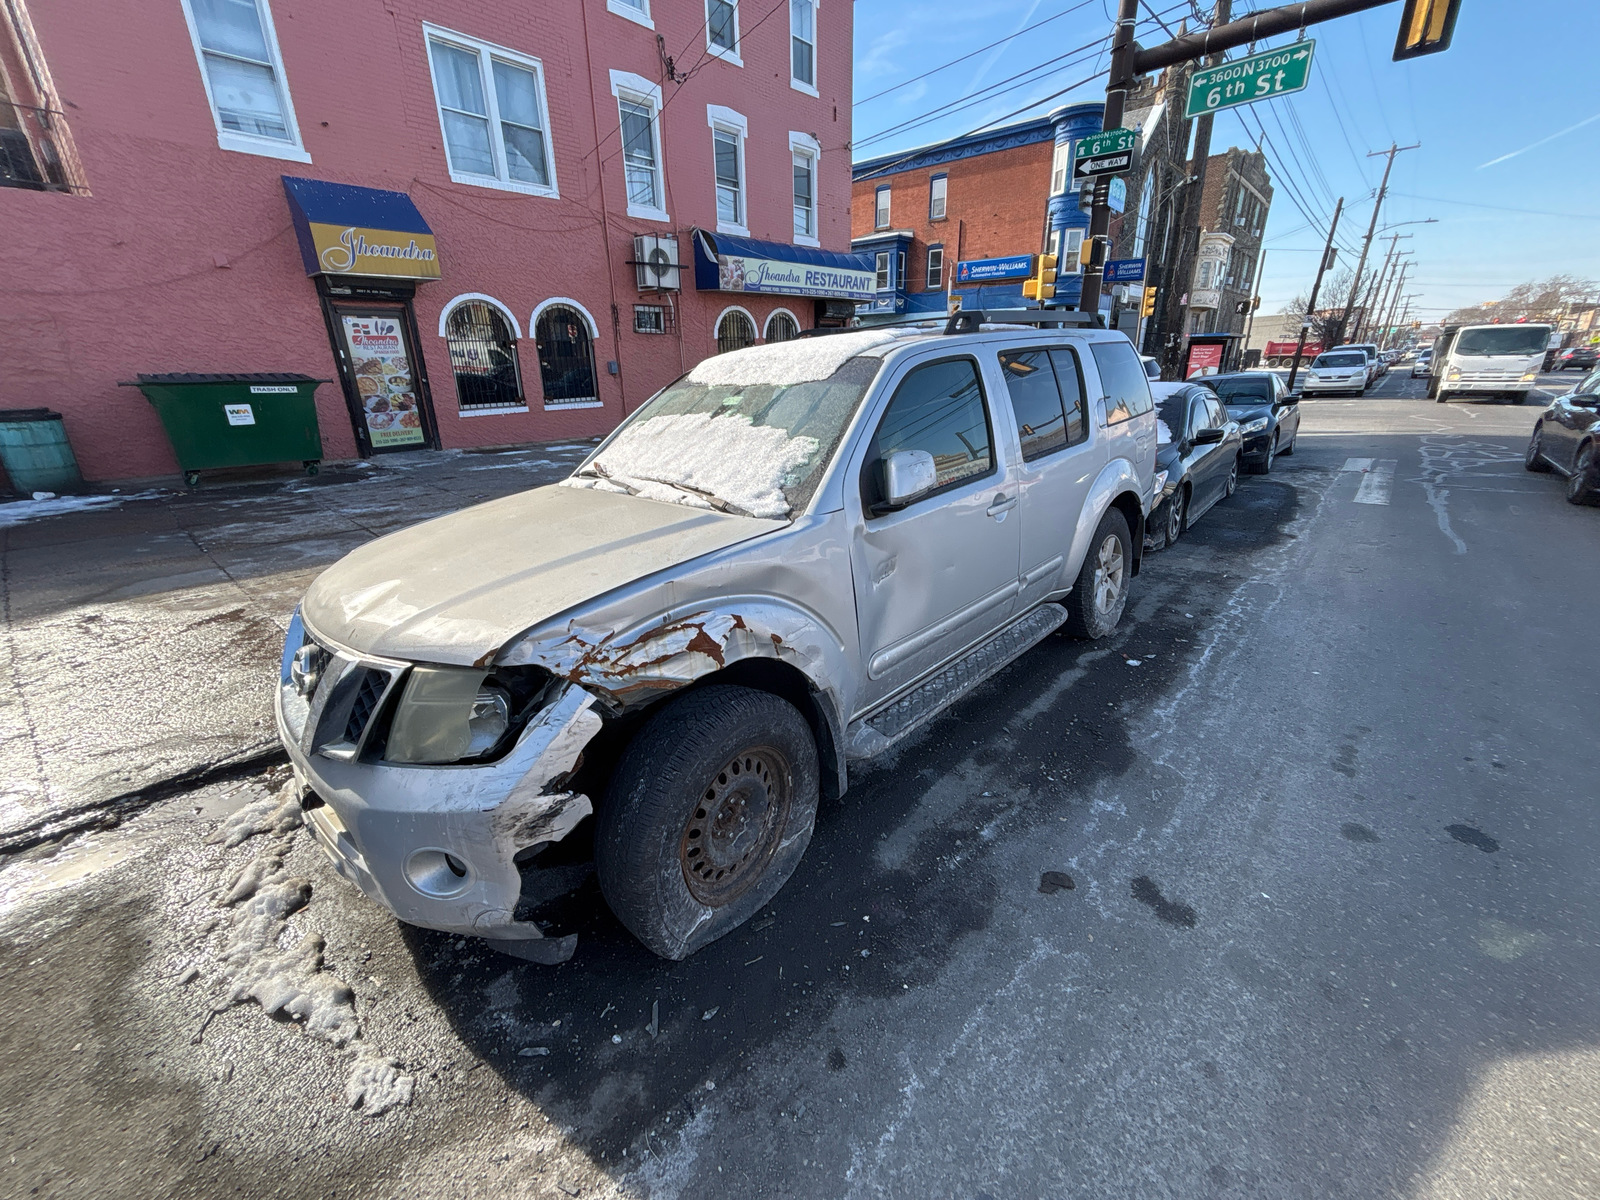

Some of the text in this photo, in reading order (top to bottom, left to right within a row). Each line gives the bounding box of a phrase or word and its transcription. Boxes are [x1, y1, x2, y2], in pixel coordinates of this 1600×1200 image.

[1209, 53, 1290, 84] 3600 N 3700
[1206, 69, 1286, 108] 6th St
[1092, 135, 1134, 154] 6th St
[1090, 157, 1124, 169] ONE WAY
[321, 227, 435, 272] Jhoandra
[745, 262, 872, 291] Jhoandra RESTAURANT
